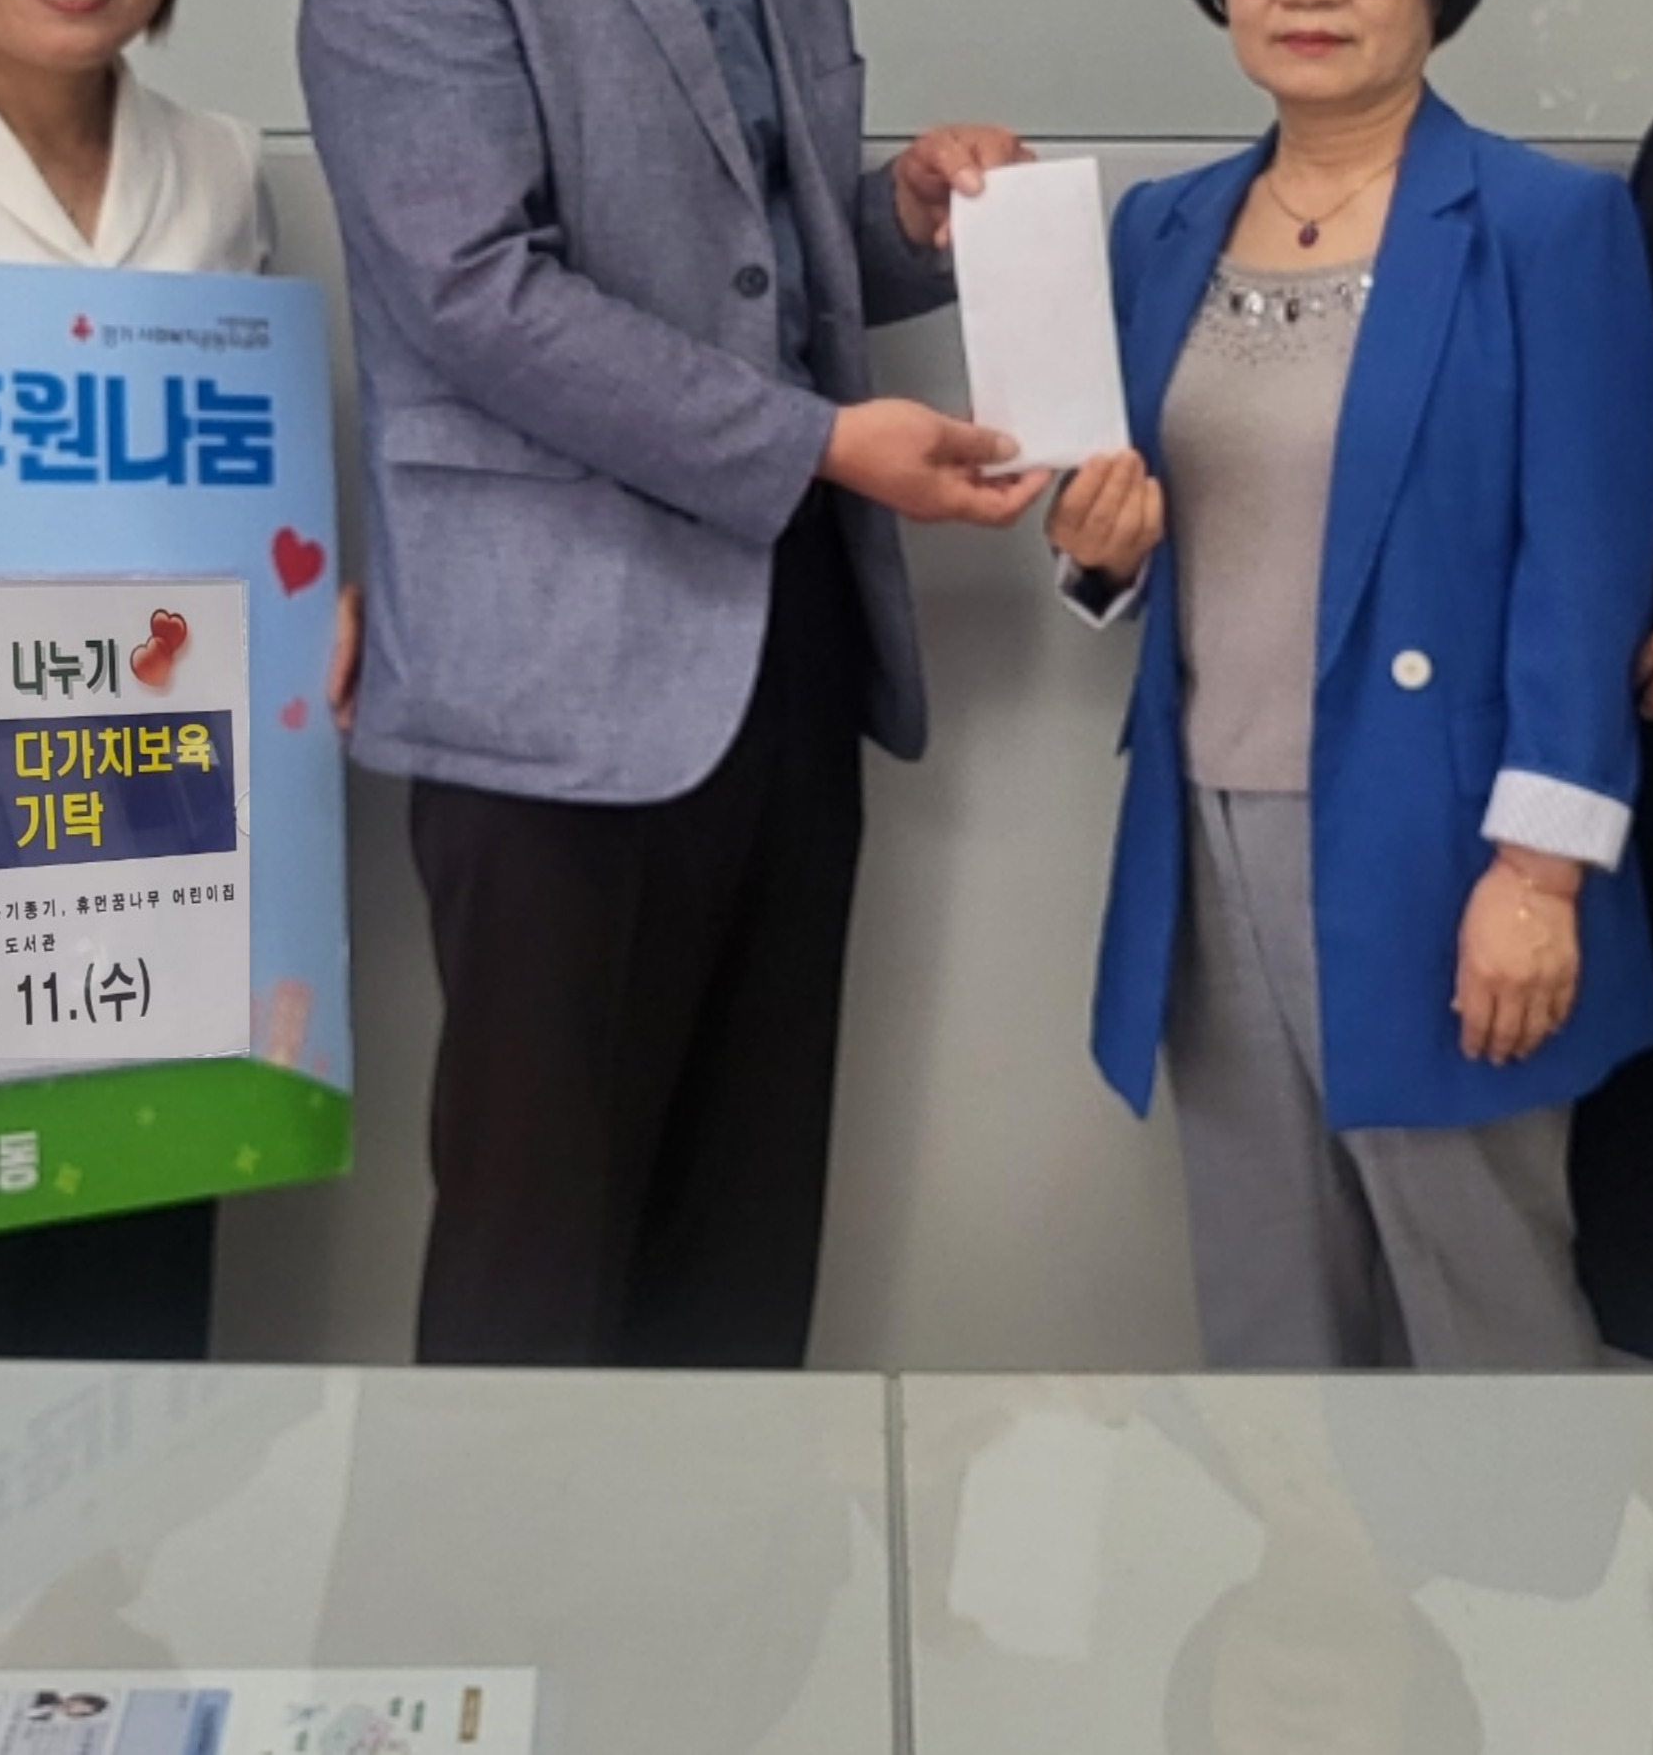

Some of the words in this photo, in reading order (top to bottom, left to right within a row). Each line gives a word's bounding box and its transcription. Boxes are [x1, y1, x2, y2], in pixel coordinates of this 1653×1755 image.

[12, 638, 119, 695] 나누기
[15, 723, 212, 781] 다가치보육
[17, 791, 104, 851] 기탁
[76, 889, 161, 915] 휴먼꿈나무
[172, 883, 236, 905] 어린이집
[5, 932, 56, 955] 도서관
[17, 958, 151, 1027] 11.(수)
